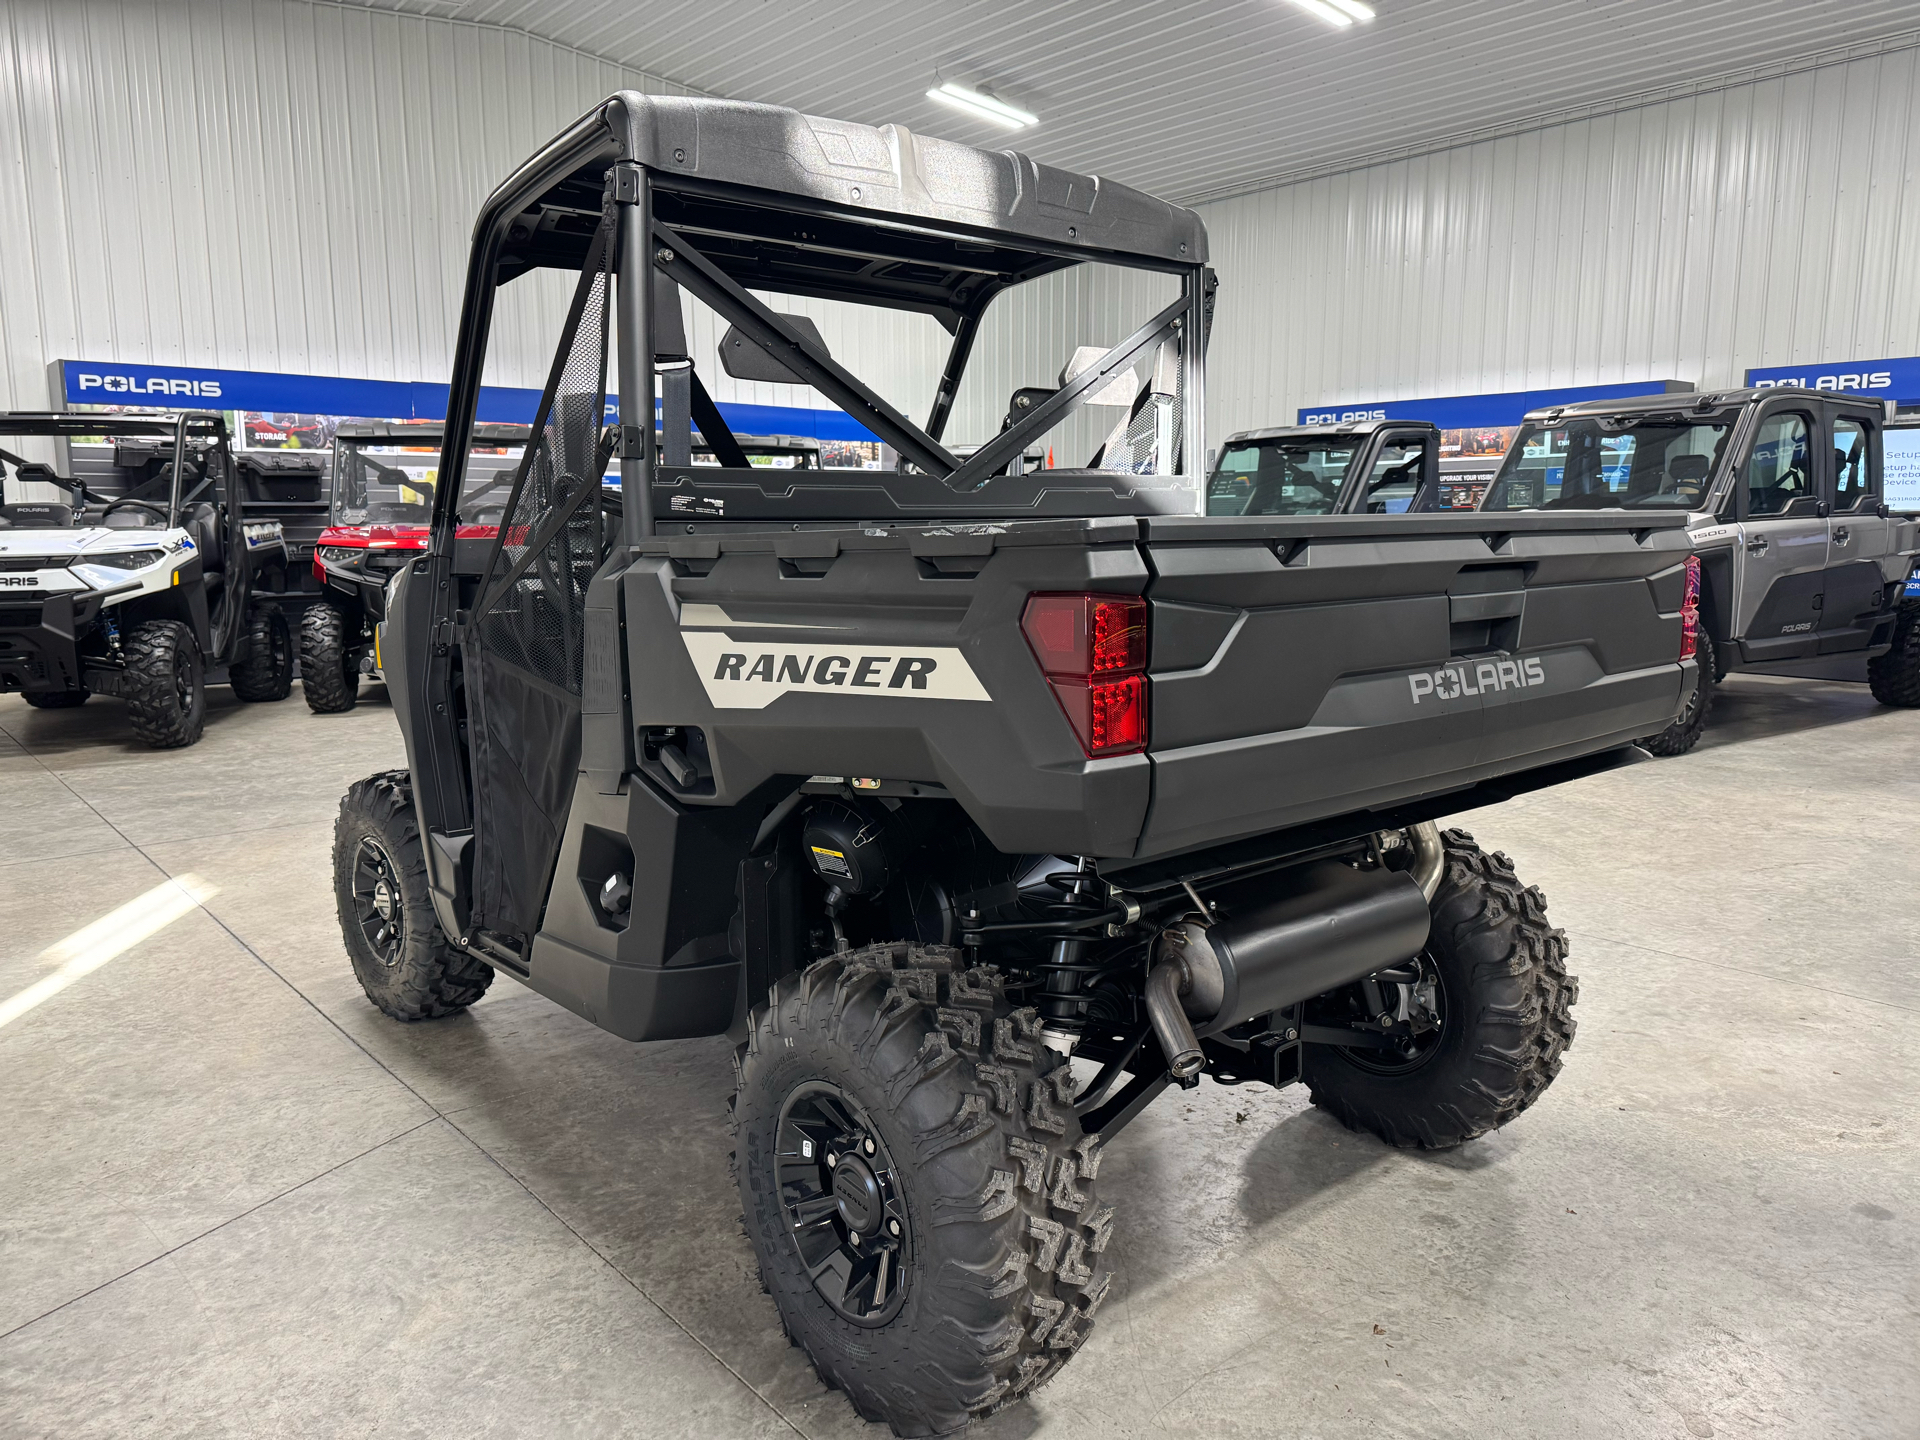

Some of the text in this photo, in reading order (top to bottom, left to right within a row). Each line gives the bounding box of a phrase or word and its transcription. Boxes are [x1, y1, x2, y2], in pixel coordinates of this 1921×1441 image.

[78, 374, 222, 398] POLARIS
[1305, 410, 1386, 425] POLARIS
[254, 432, 288, 441] STORAGE
[1886, 451, 1920, 460] Setup
[1883, 464, 1907, 472] etup
[1693, 529, 1727, 540] 1500
[172, 535, 189, 549] XP
[1781, 622, 1811, 634] POLARIS
[713, 653, 938, 690] RANGER
[1408, 656, 1545, 705] POLARIS
